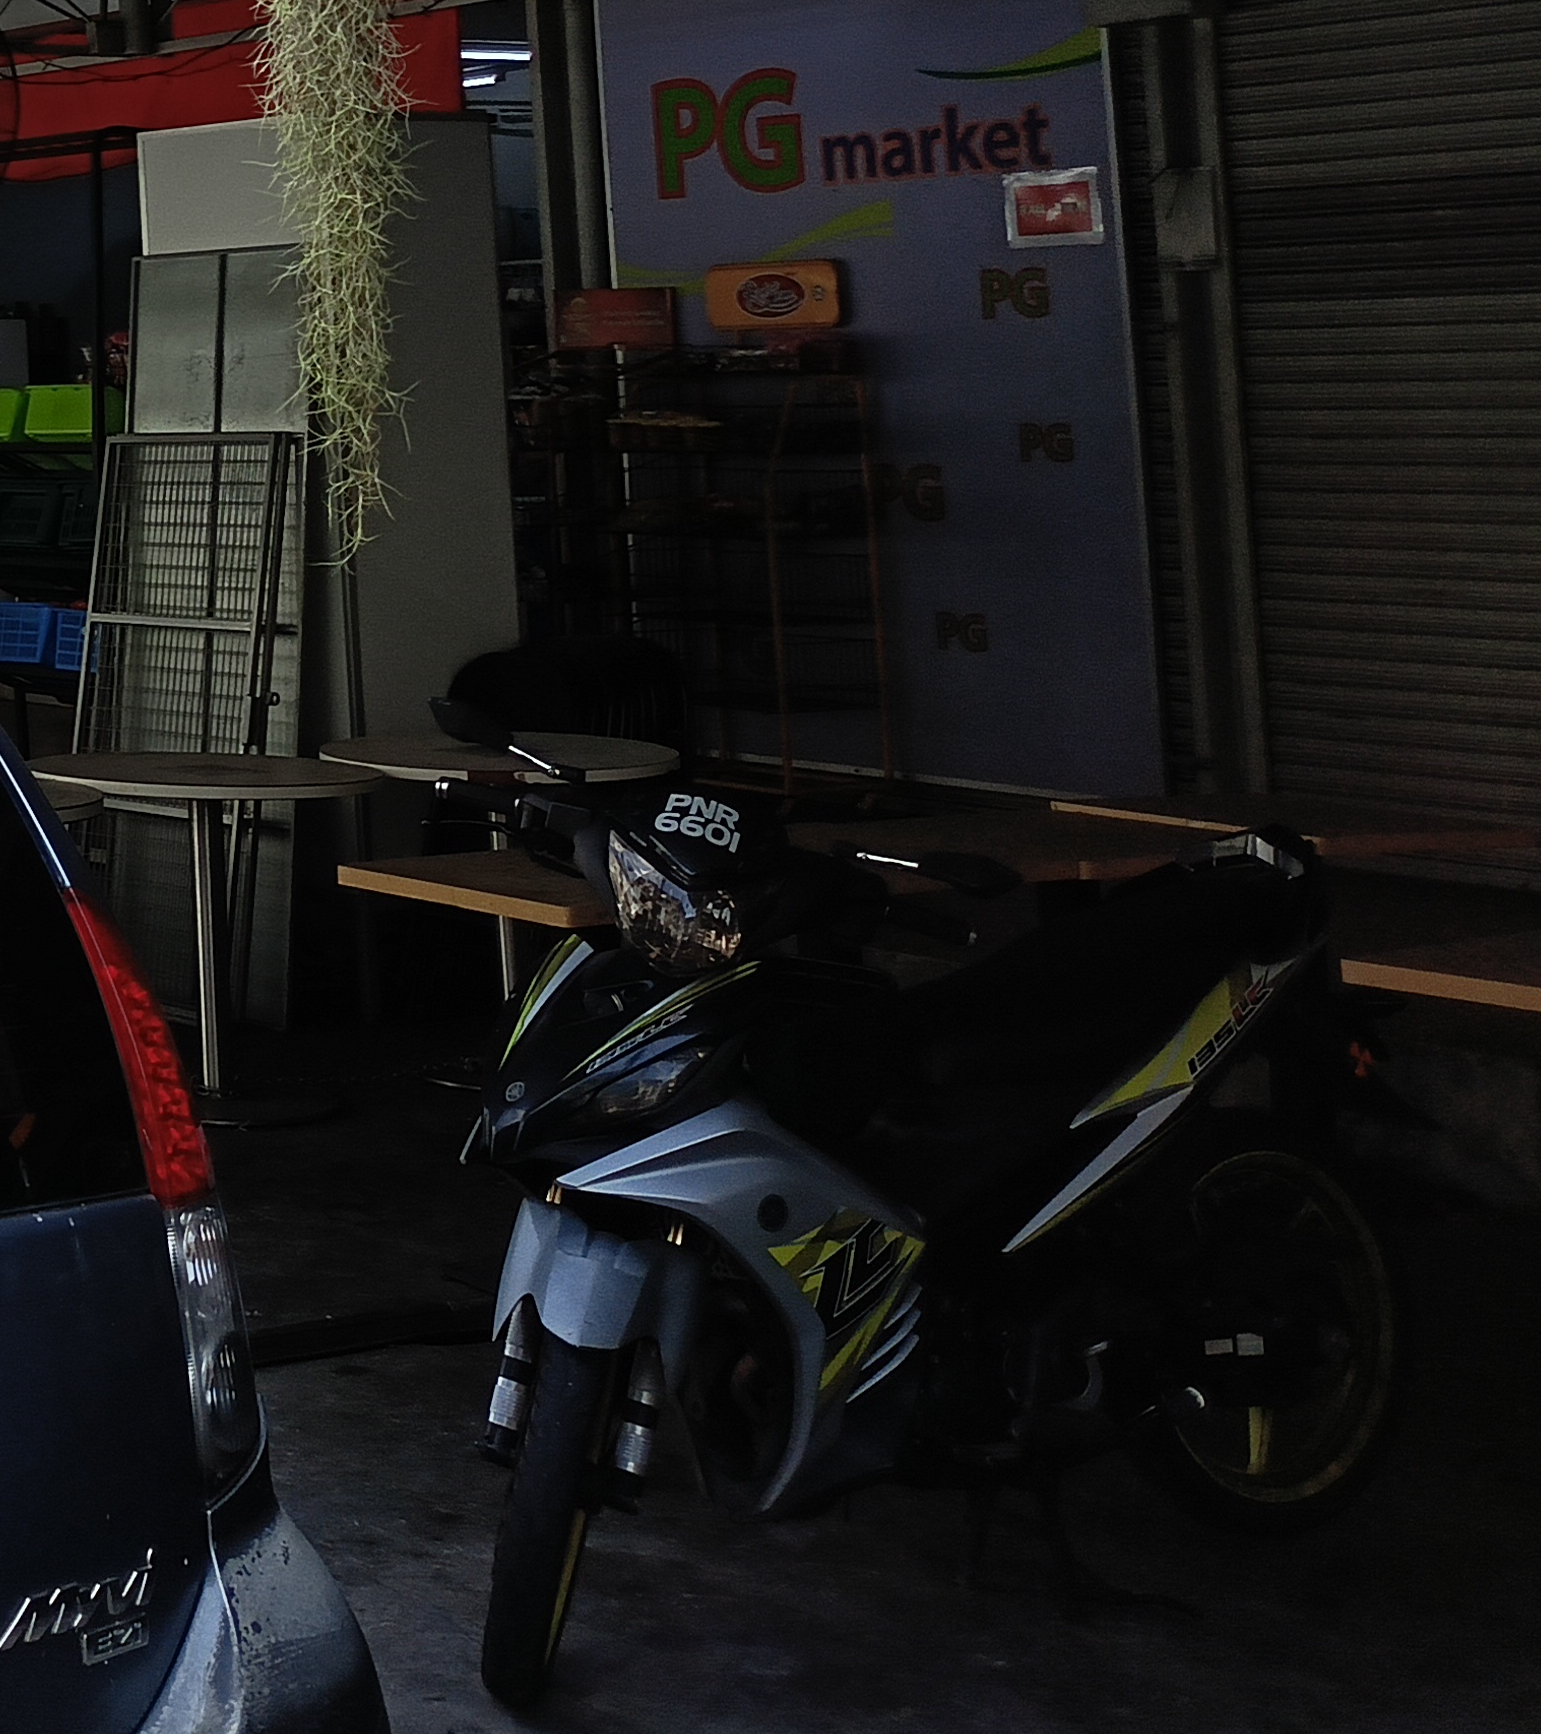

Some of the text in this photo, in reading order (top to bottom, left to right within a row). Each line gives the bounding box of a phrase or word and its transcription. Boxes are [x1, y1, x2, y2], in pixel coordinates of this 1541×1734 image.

[651, 68, 1052, 199] PG market
[980, 267, 1050, 319] PG
[1019, 422, 1074, 464] PG
[936, 611, 988, 653] PG
[665, 793, 740, 830] PNR
[654, 812, 741, 854] 6601
